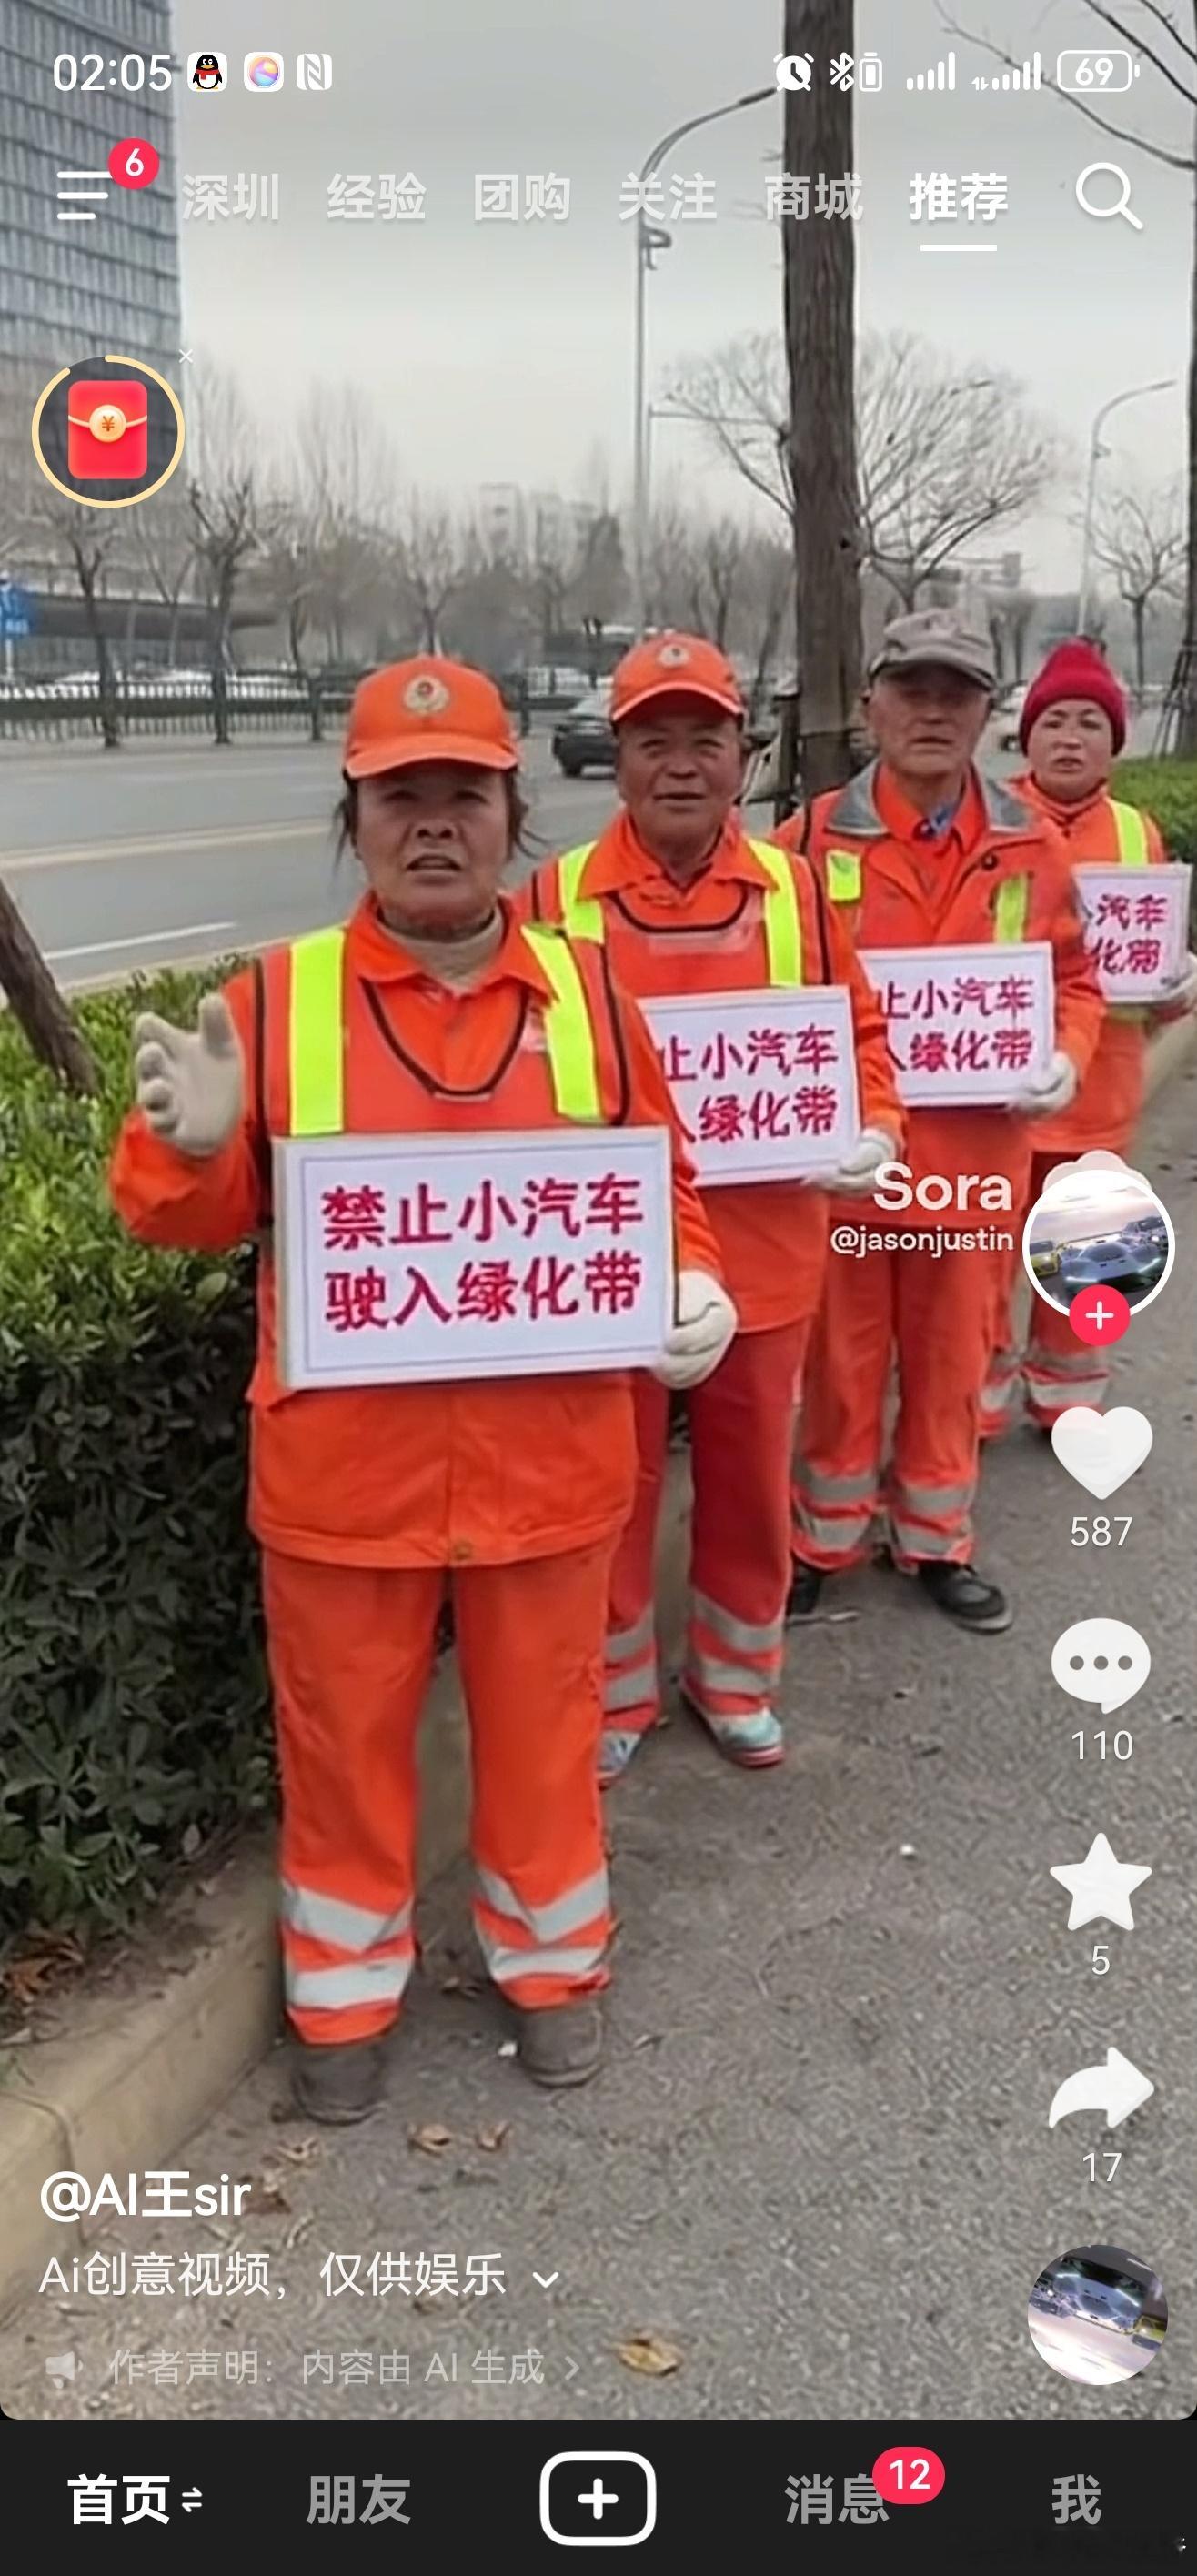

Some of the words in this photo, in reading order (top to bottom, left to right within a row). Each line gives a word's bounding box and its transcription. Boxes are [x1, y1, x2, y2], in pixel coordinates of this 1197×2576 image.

[659, 1023, 839, 1081] 止小汽车
[682, 1085, 838, 1143] 绿化带
[321, 1172, 644, 1251] 禁止小汽车
[324, 1249, 642, 1332] 驶入绿化带
